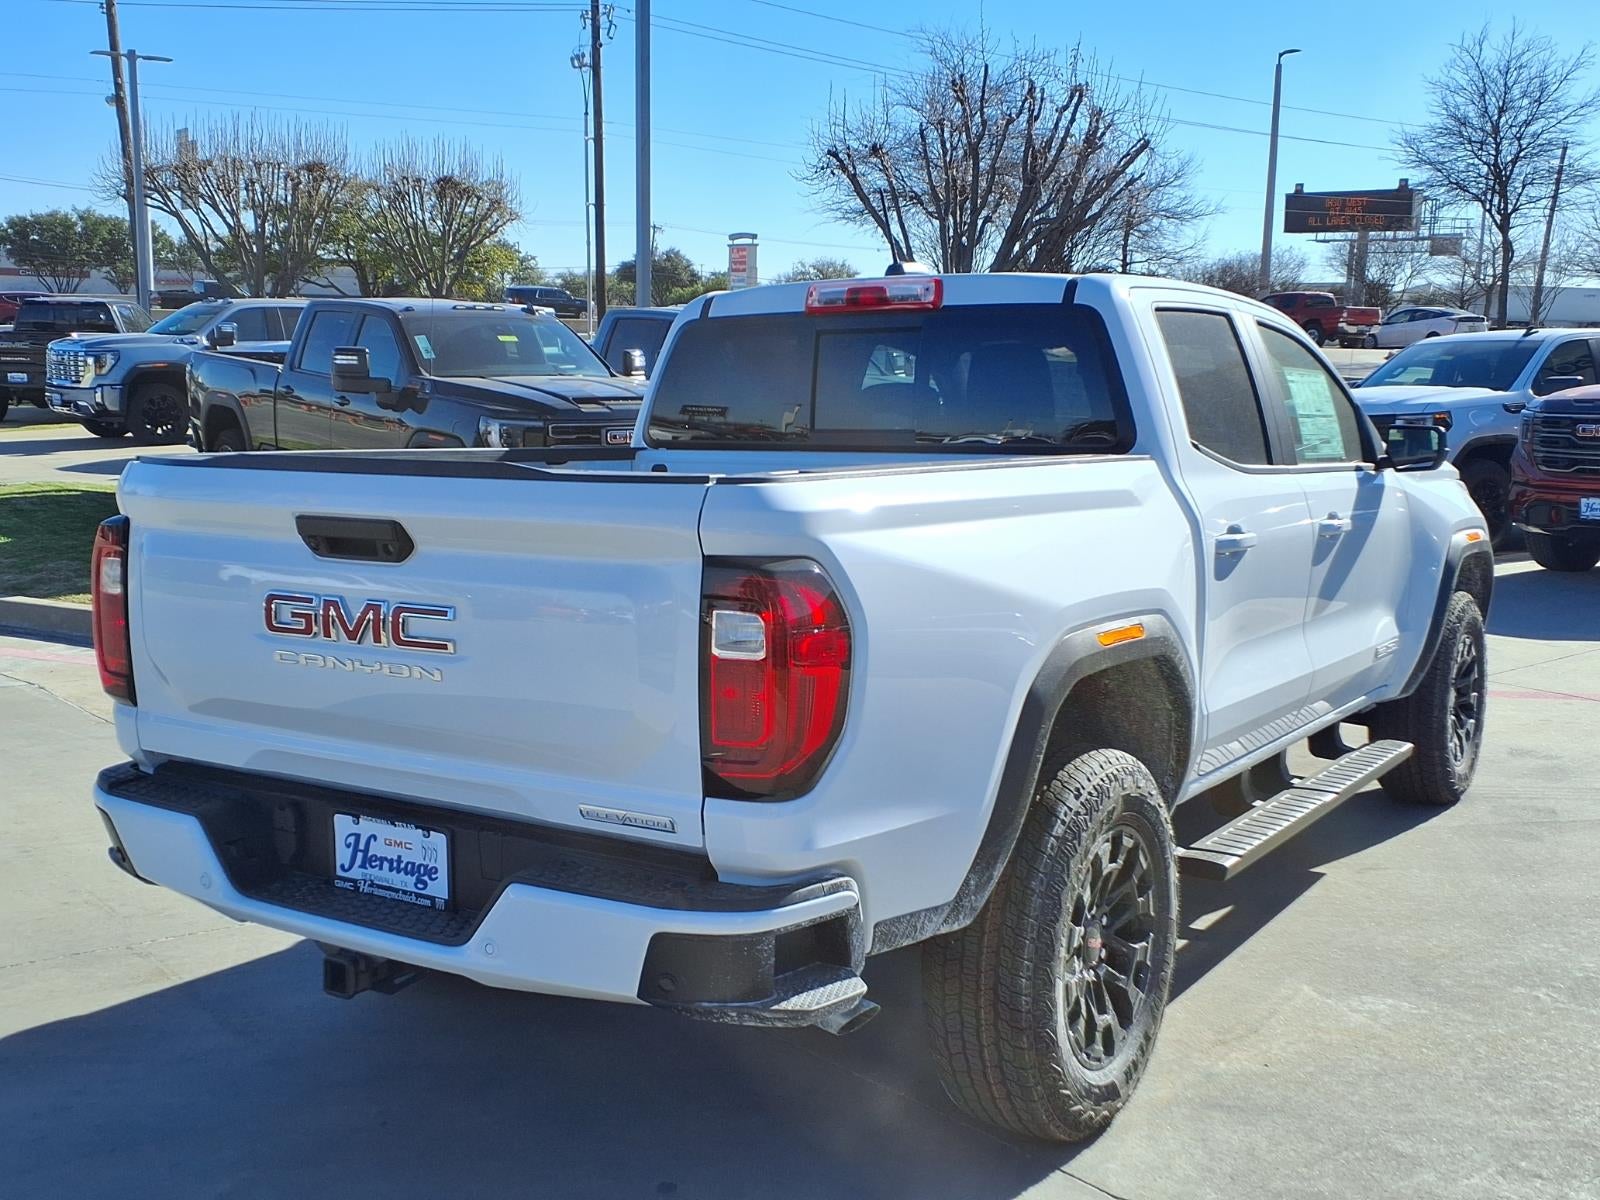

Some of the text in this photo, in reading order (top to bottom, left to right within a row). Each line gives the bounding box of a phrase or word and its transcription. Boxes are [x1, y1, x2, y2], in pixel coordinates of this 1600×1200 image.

[1346, 197, 1367, 207] WEST
[1307, 214, 1385, 226] ALL LANES CLOSED
[263, 589, 456, 655] GMC
[272, 649, 443, 682] CANYON
[585, 809, 668, 829] ELEVATION
[383, 837, 414, 851] GMC
[339, 832, 440, 891] Heritage
